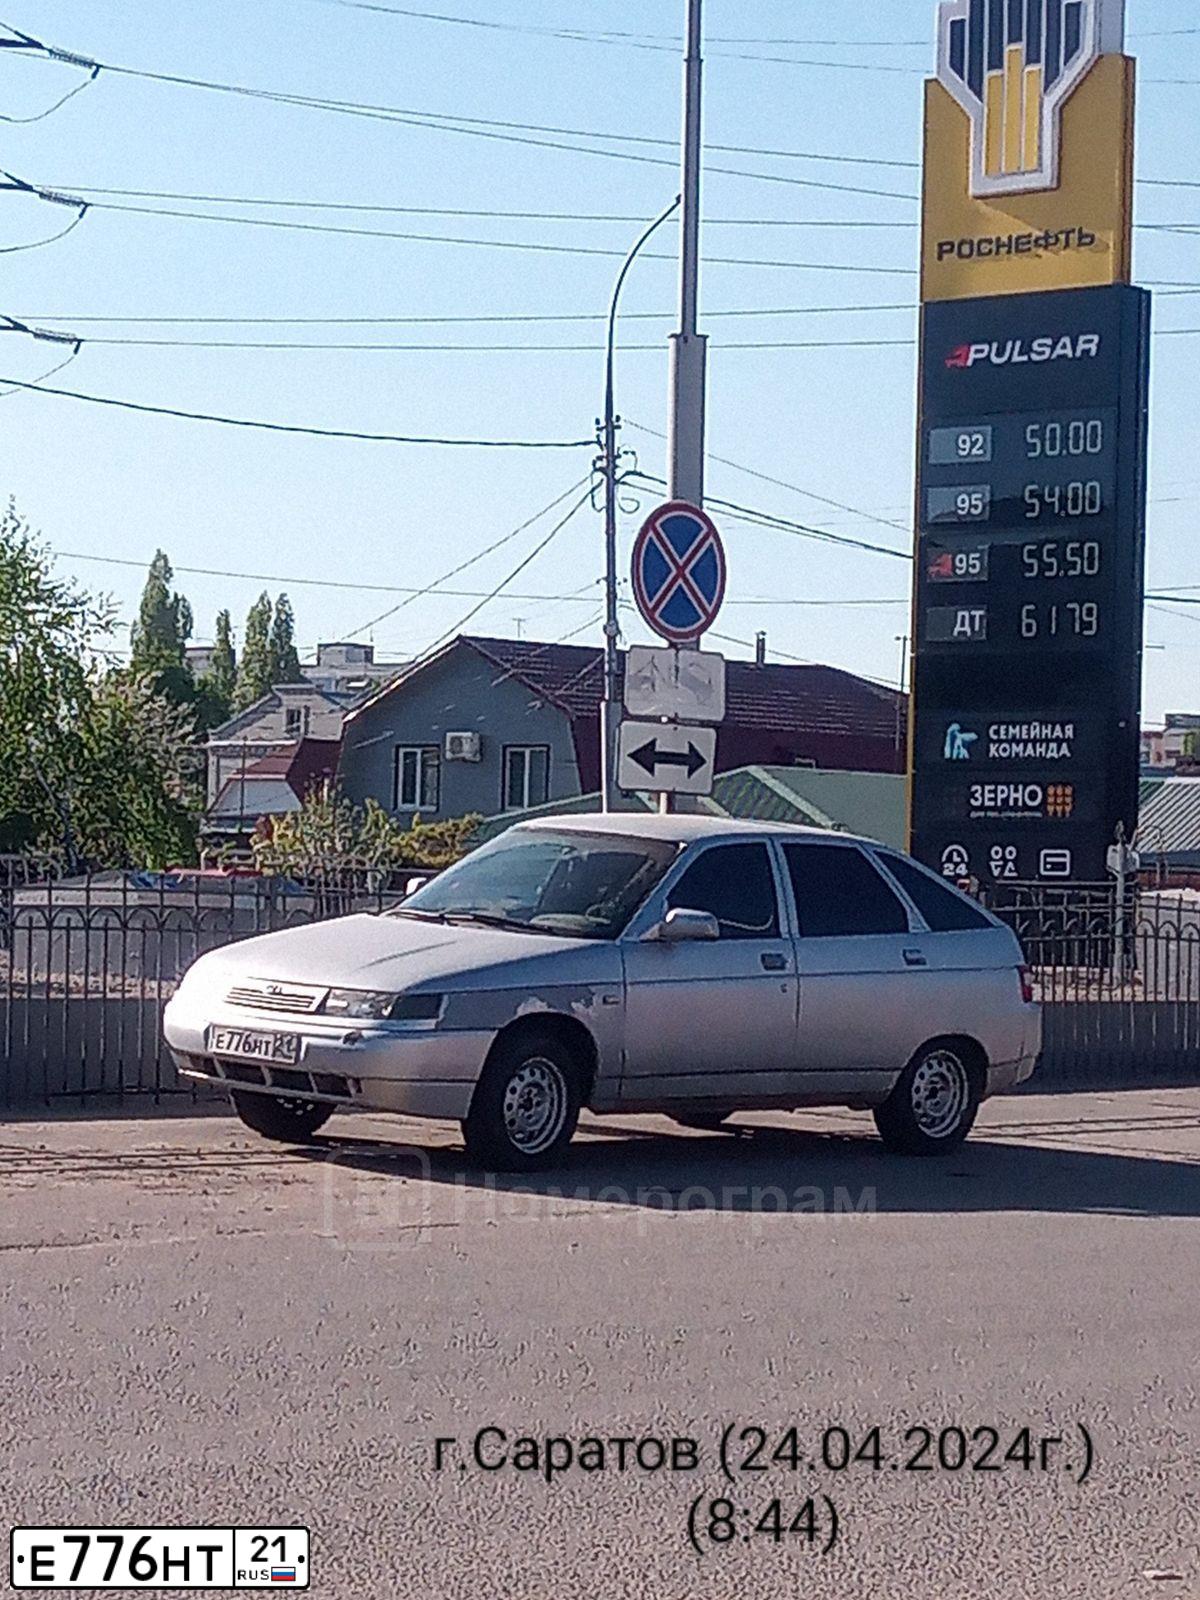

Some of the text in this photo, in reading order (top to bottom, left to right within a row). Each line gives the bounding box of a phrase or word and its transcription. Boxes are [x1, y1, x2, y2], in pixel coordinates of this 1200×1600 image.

[937, 226, 1095, 261] РОСНЕФТЬ
[966, 334, 1100, 367] PULSAR
[957, 420, 1102, 457] 92 50.00
[956, 480, 1101, 518] 95 54.00
[954, 541, 1100, 577] 95 55.50
[953, 609, 985, 637] ДТ
[988, 721, 1075, 740] СЕМЕЙНАЯ
[988, 742, 1072, 759] КОМАНДА
[969, 784, 1043, 807] ЗЕРНО
[942, 862, 969, 877] 24
